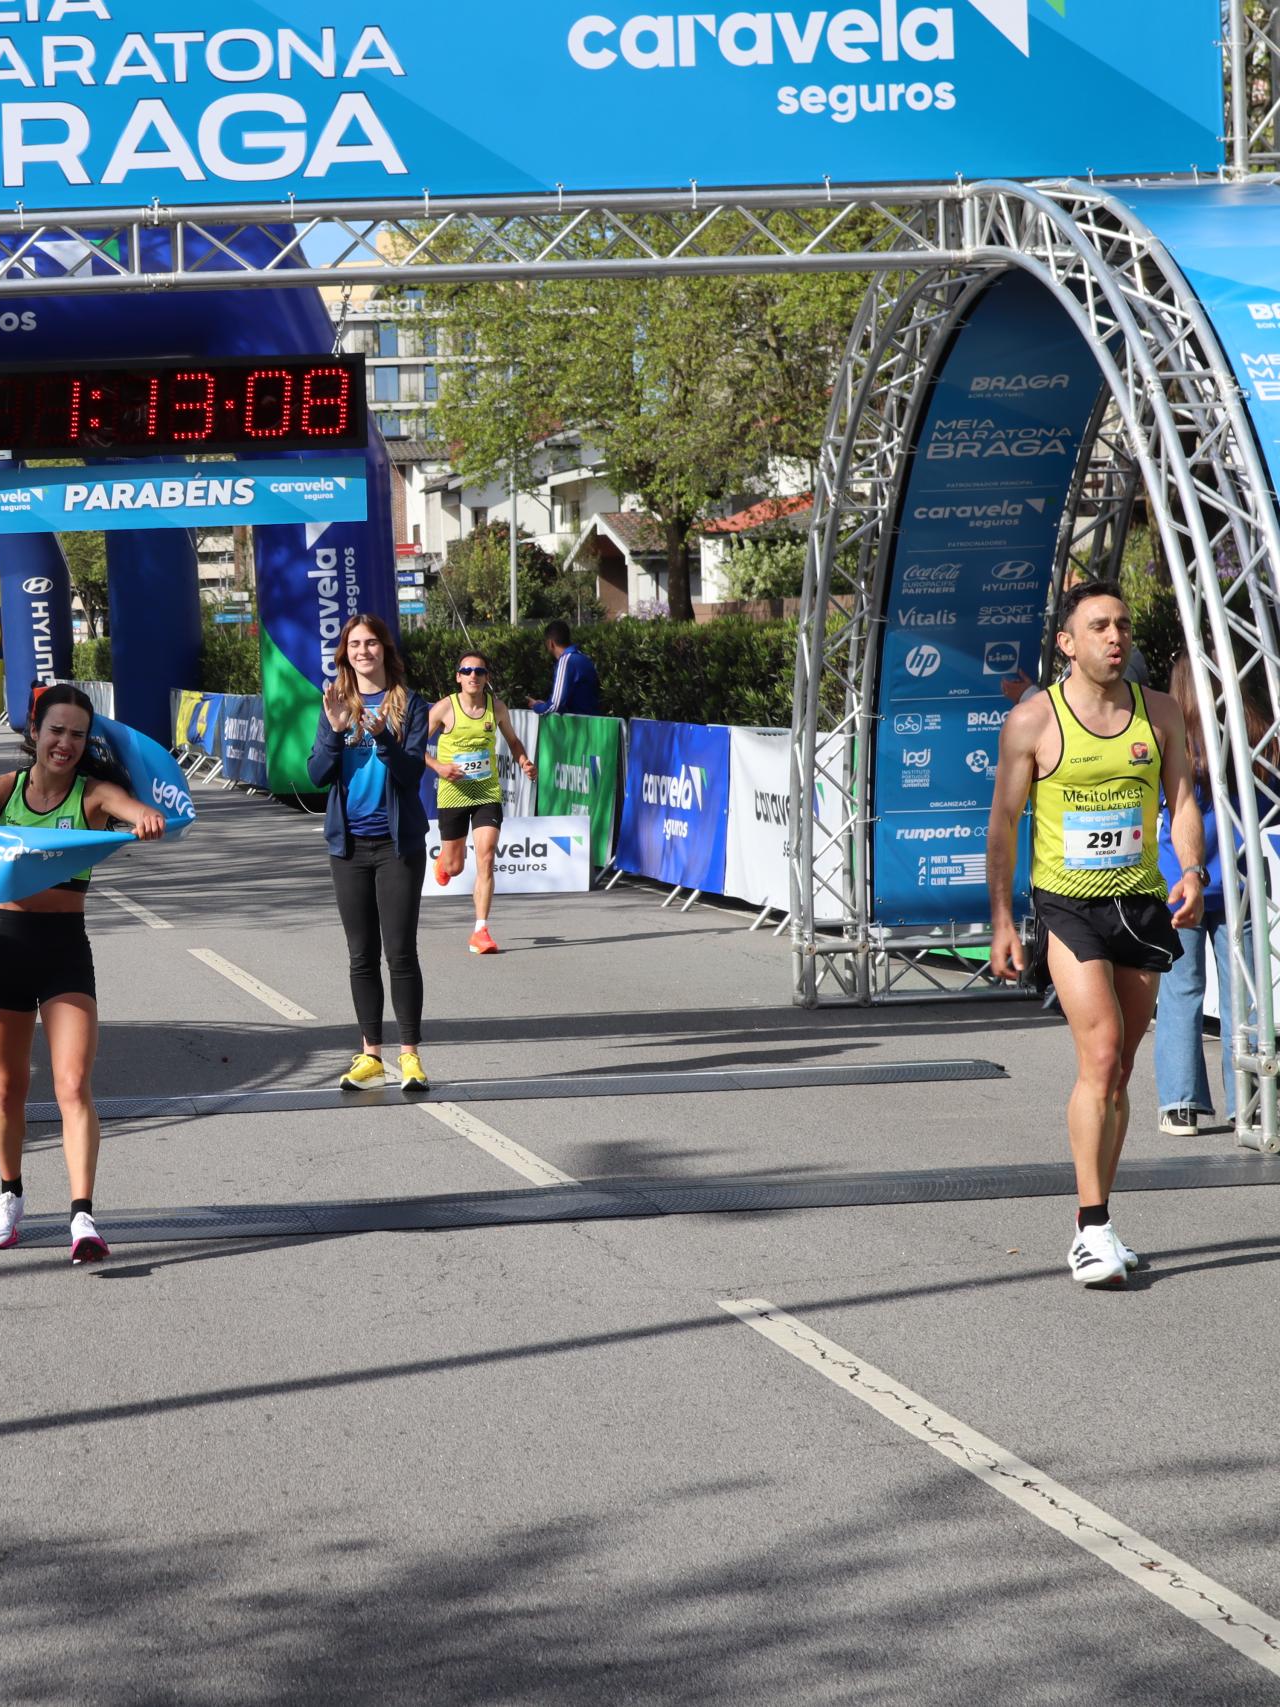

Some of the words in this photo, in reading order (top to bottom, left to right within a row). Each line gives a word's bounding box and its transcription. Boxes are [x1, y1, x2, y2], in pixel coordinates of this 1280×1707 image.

[567, 0, 955, 70] caravela
[776, 80, 956, 124] seguros
[970, 374, 1070, 392] BRAGA
[935, 418, 995, 430] MEIA
[930, 427, 1071, 441] MARATONA
[926, 438, 1067, 460] BRAGA
[64, 472, 255, 511] PARABÉNS
[270, 477, 334, 494] caravela
[303, 491, 334, 501] seguros
[0, 503, 31, 512] seguros
[914, 500, 1023, 520] caravela
[969, 517, 1019, 529] seguros
[344, 547, 360, 616] seguros
[982, 581, 1039, 592] HYUNDAI
[901, 586, 956, 595] PARTNERS
[897, 606, 957, 626] Vitalis
[979, 604, 1035, 615] SPORT
[976, 613, 1033, 625] ZONE
[464, 761, 483, 771] 292
[902, 748, 931, 767] ipdj
[554, 755, 590, 794] caravela
[642, 764, 693, 810] caravela
[1063, 786, 1144, 803] MéritoInvest
[1075, 803, 1105, 812] MIGUEL
[1107, 801, 1141, 811] AZEVEDO
[1086, 830, 1123, 849] 291
[492, 863, 548, 875] seguros
